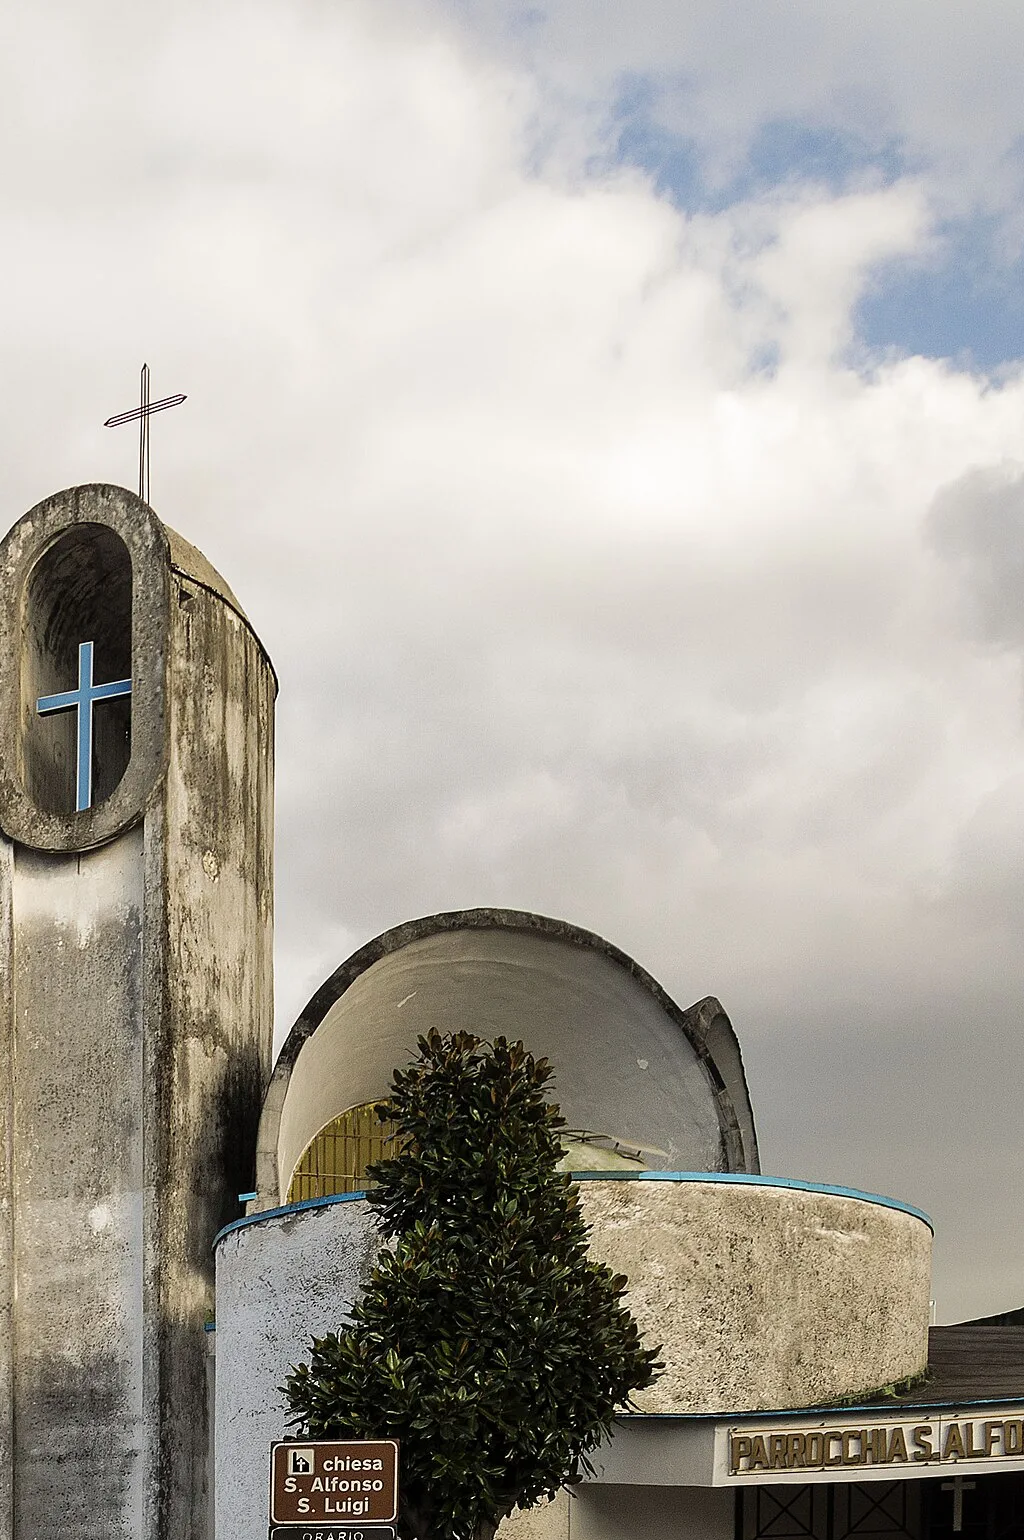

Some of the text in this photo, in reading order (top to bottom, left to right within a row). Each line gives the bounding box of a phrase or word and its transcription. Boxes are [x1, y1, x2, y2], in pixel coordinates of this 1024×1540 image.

[731, 1427, 908, 1469] PARROCCHIA
[942, 1419, 1024, 1458] ALFO
[323, 1455, 383, 1471] chiesa
[284, 1477, 384, 1493] S. Alfonso
[297, 1496, 370, 1515] S. Luigi
